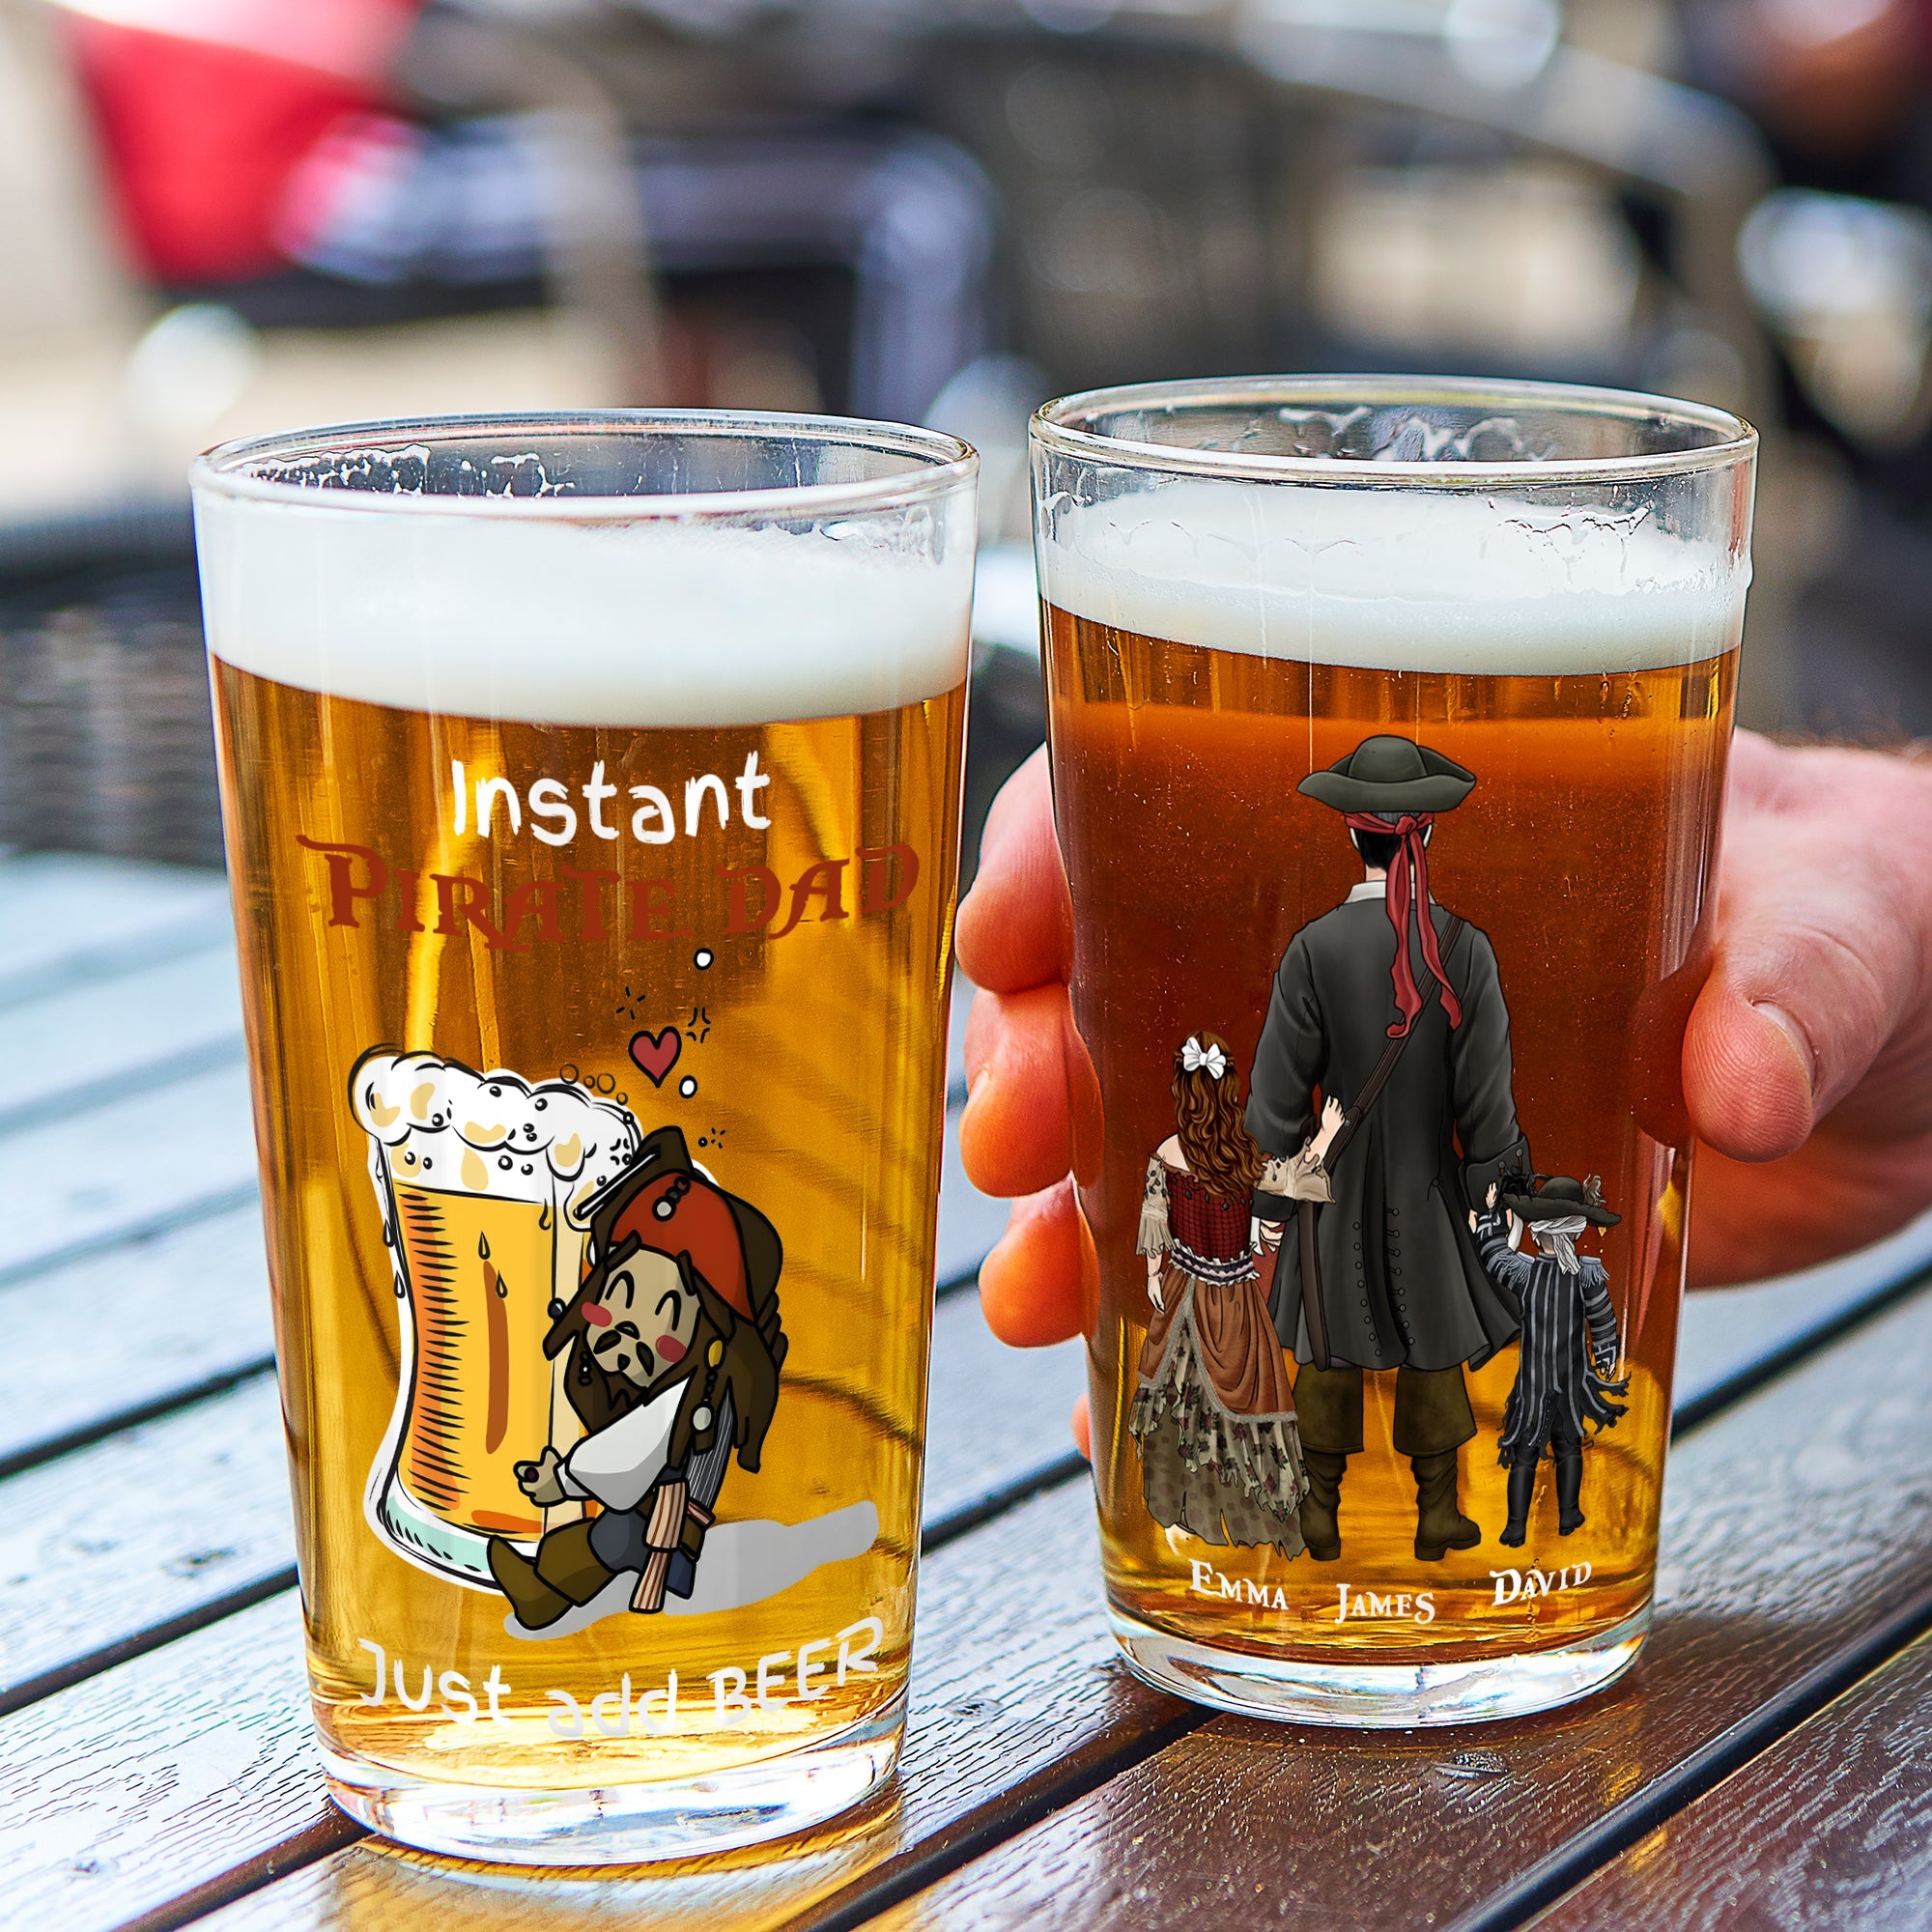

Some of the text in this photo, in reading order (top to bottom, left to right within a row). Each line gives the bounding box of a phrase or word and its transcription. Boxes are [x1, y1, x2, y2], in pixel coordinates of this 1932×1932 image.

[451, 751, 771, 846] Instant
[296, 834, 921, 952] PIRATE DAD
[1334, 1582, 1435, 1625] JAMES
[1489, 1561, 1593, 1607] DAVID
[547, 1668, 679, 1738] add
[707, 1616, 884, 1727] BEER
